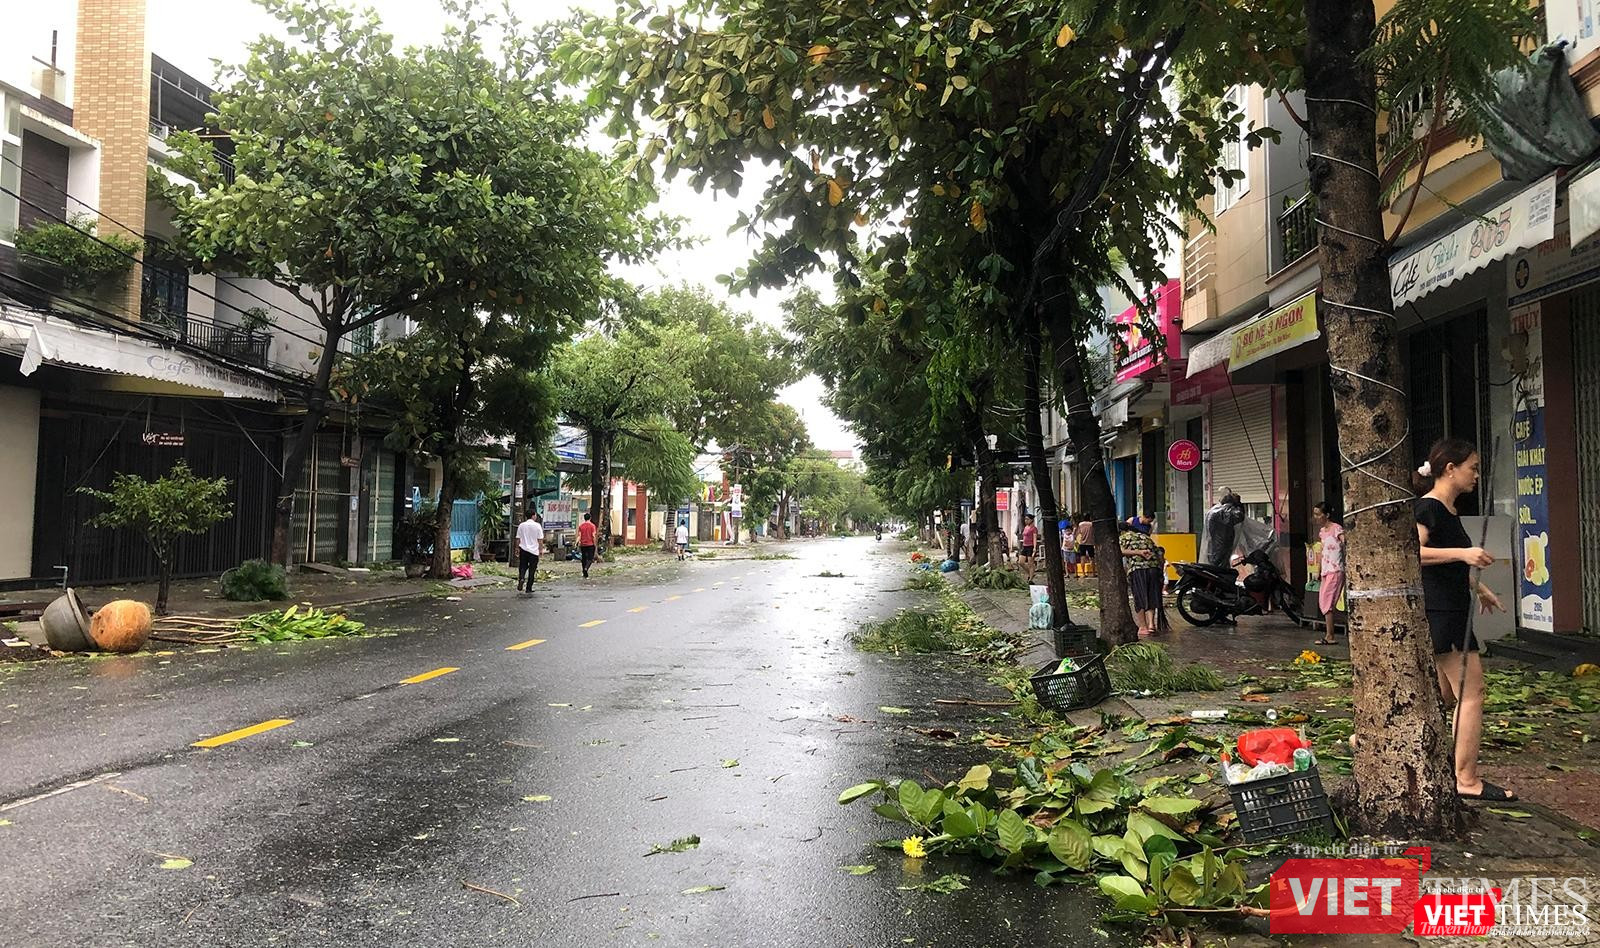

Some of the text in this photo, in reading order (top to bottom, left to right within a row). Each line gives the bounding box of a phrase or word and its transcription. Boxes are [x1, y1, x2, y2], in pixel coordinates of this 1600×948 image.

[1468, 207, 1512, 261] 205
[1515, 417, 1530, 439] CAFÉ
[1529, 443, 1545, 466] KHÁT
